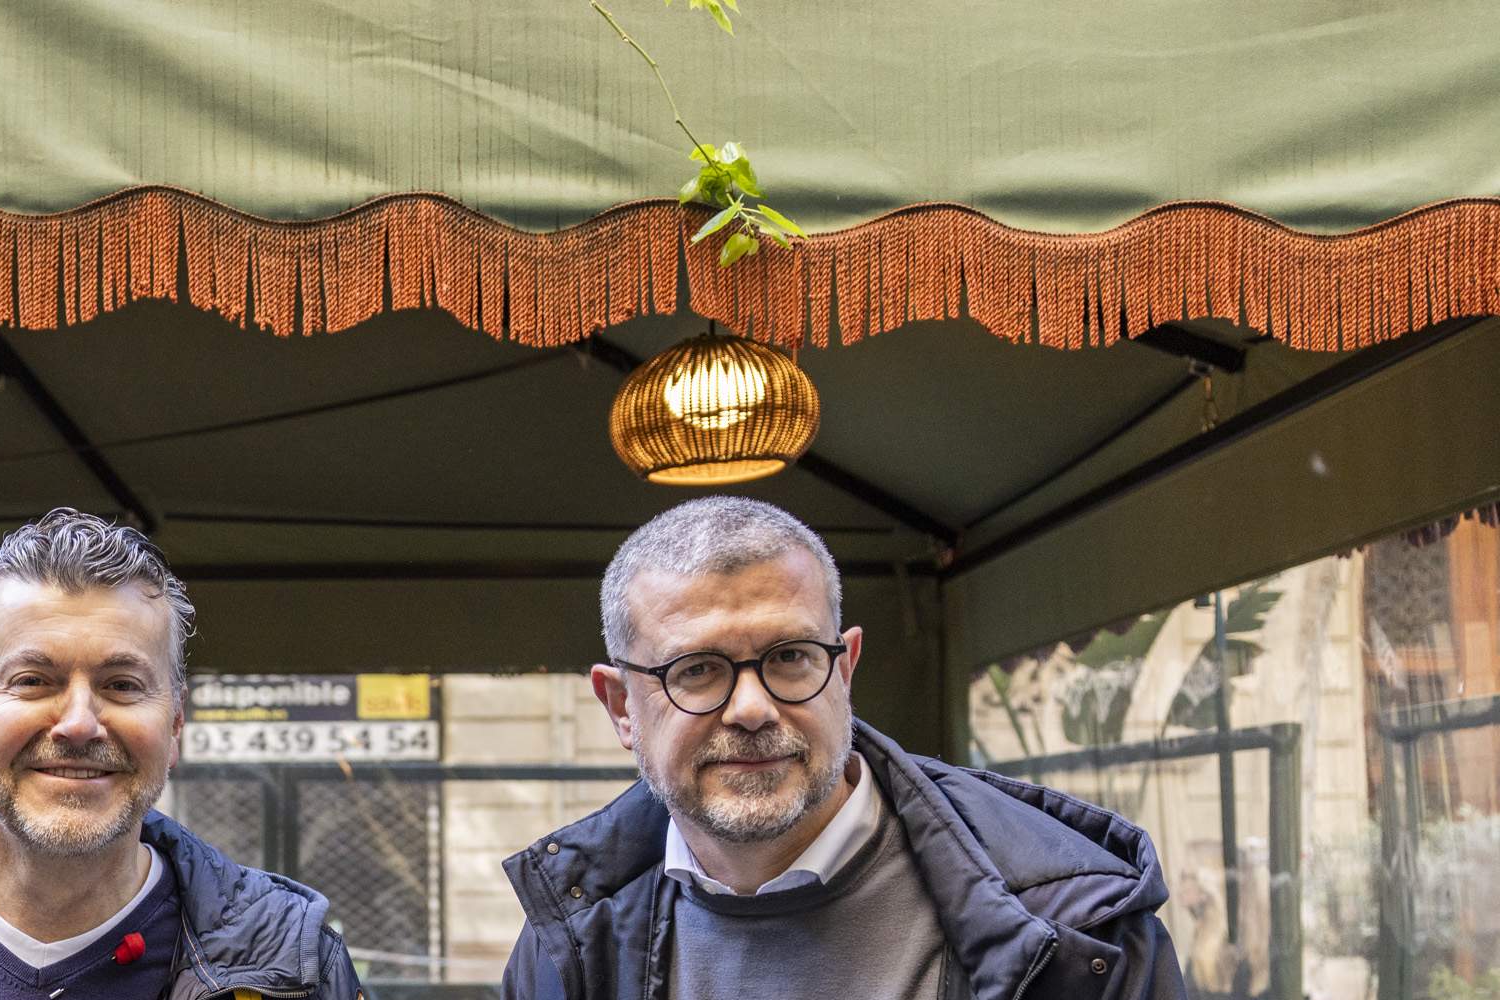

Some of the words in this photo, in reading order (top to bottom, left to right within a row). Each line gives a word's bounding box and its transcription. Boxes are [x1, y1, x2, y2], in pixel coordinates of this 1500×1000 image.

[191, 681, 351, 709] disponible
[191, 727, 233, 751] 93
[249, 727, 315, 751] 439
[386, 726, 430, 751] 54
